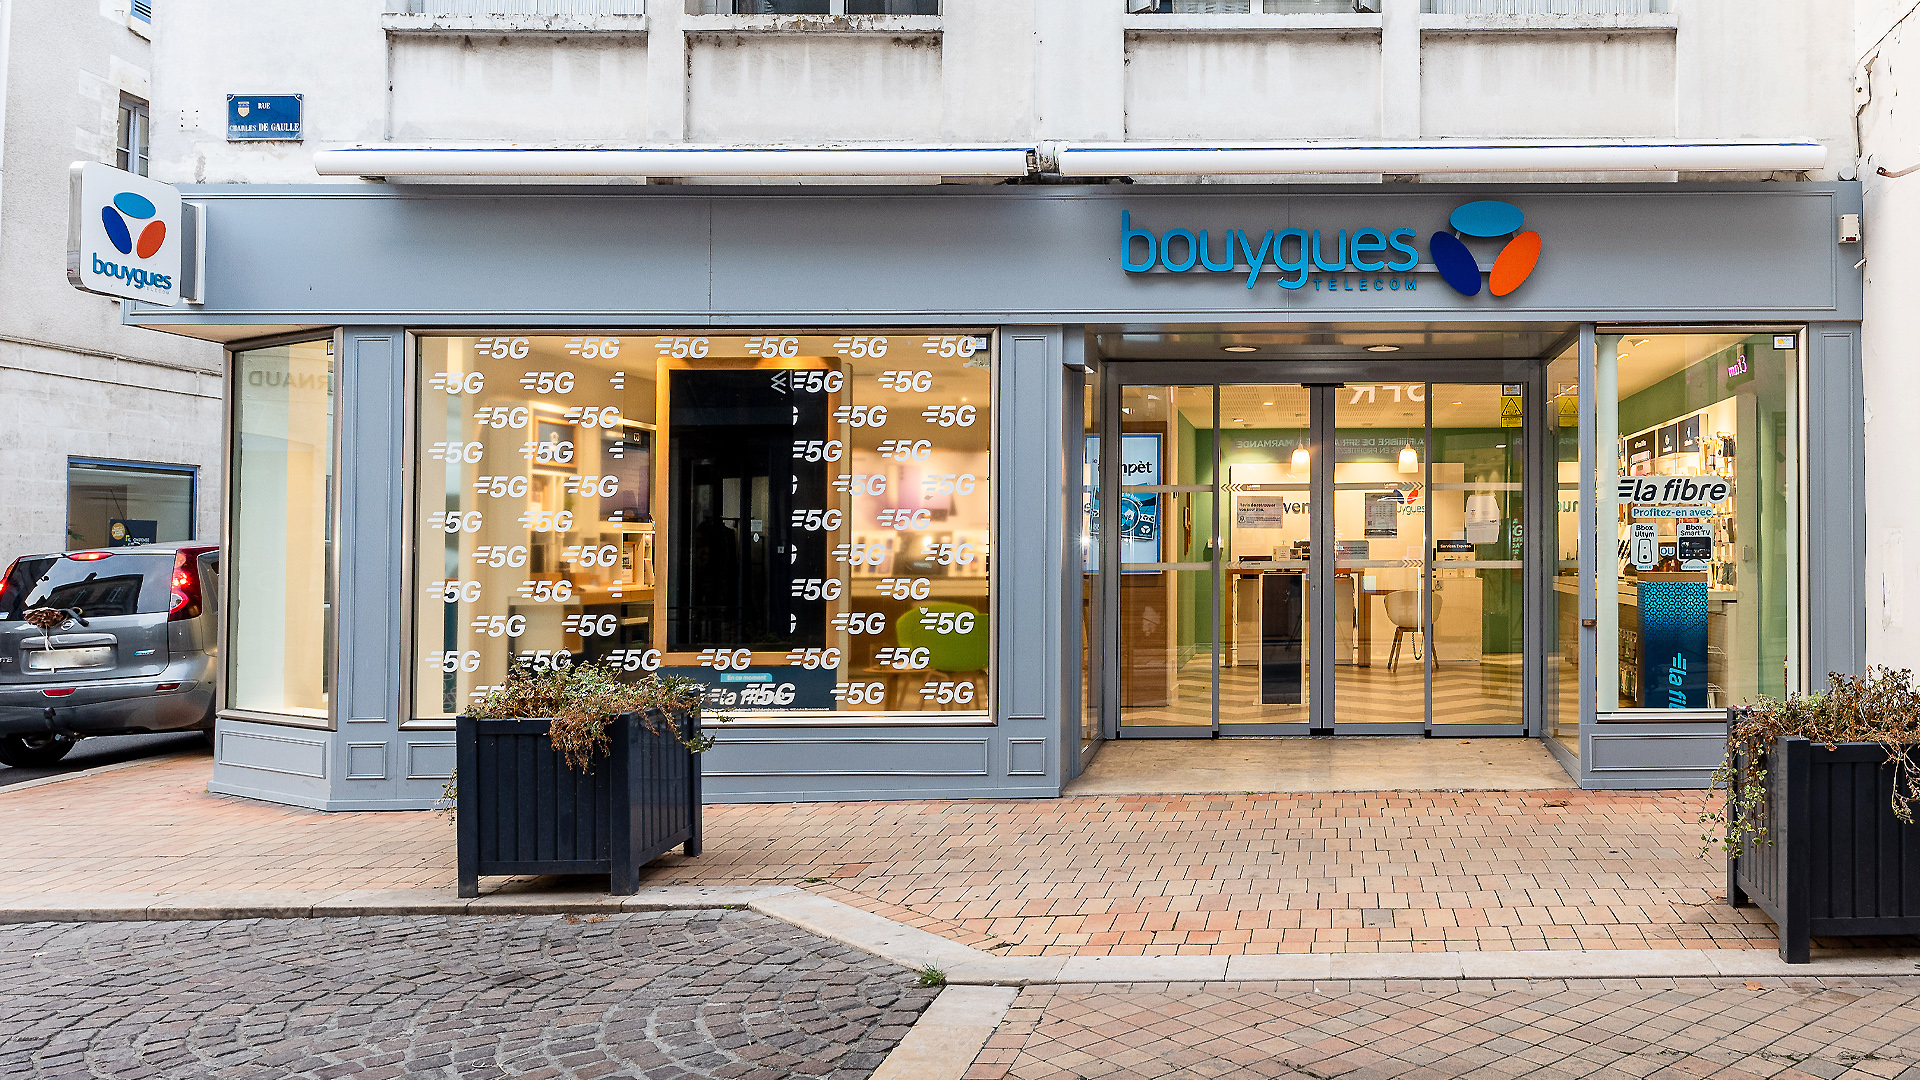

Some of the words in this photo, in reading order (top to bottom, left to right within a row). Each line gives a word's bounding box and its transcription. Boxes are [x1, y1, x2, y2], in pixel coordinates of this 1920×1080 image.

[257, 102, 271, 110] RUE
[229, 124, 257, 132] CHARLES
[258, 122, 269, 132] DE
[270, 122, 300, 132] GAULLE
[1121, 209, 1420, 290] bouygues
[92, 252, 172, 290] bouygues
[1313, 279, 1418, 291] TELECOM
[491, 336, 530, 359] 5G
[581, 336, 620, 359] 5G
[671, 336, 710, 359] 5G
[760, 336, 799, 359] 5G
[849, 335, 888, 358] 5G
[445, 371, 484, 394] 5G
[536, 371, 575, 394] 5G
[805, 370, 844, 393] 5G
[894, 370, 933, 393] 5G
[490, 406, 529, 429] 5G
[580, 405, 619, 428] 5G
[849, 404, 888, 427] 5G
[938, 404, 977, 427] 5G
[444, 441, 483, 464] 5G
[535, 440, 574, 463] 5G
[804, 439, 843, 462] 5G
[893, 439, 932, 462] 5G
[489, 475, 528, 498] 5G
[580, 474, 619, 497] 5G
[848, 473, 887, 496] 5G
[937, 473, 976, 496] 5G
[1633, 479, 1658, 502] la
[1662, 478, 1728, 502] fibre
[444, 510, 483, 533] 5G
[534, 510, 573, 533] 5G
[804, 508, 843, 531] 5G
[893, 508, 932, 531] 5G
[1633, 508, 1688, 517] Profitez-en
[1689, 508, 1712, 517] avec
[1634, 531, 1655, 539] Ultym
[488, 545, 527, 568] 5G
[579, 544, 618, 567] 5G
[848, 543, 887, 566] 5G
[937, 542, 976, 565] 5G
[1660, 547, 1675, 555] OU
[443, 580, 482, 603] 5G
[533, 579, 572, 602] 5G
[803, 578, 842, 601] 5G
[892, 577, 931, 600] 5G
[487, 614, 526, 637] 5G
[578, 613, 617, 636] 5G
[847, 612, 886, 635] 5G
[936, 611, 975, 634] 5G
[442, 649, 481, 672] 5G
[623, 648, 662, 671] 5G
[713, 648, 752, 671] 5G
[802, 647, 841, 670] 5G
[892, 646, 931, 669] 5G
[1668, 667, 1687, 686] la
[846, 682, 885, 705] 5G
[936, 681, 975, 704] 5G
